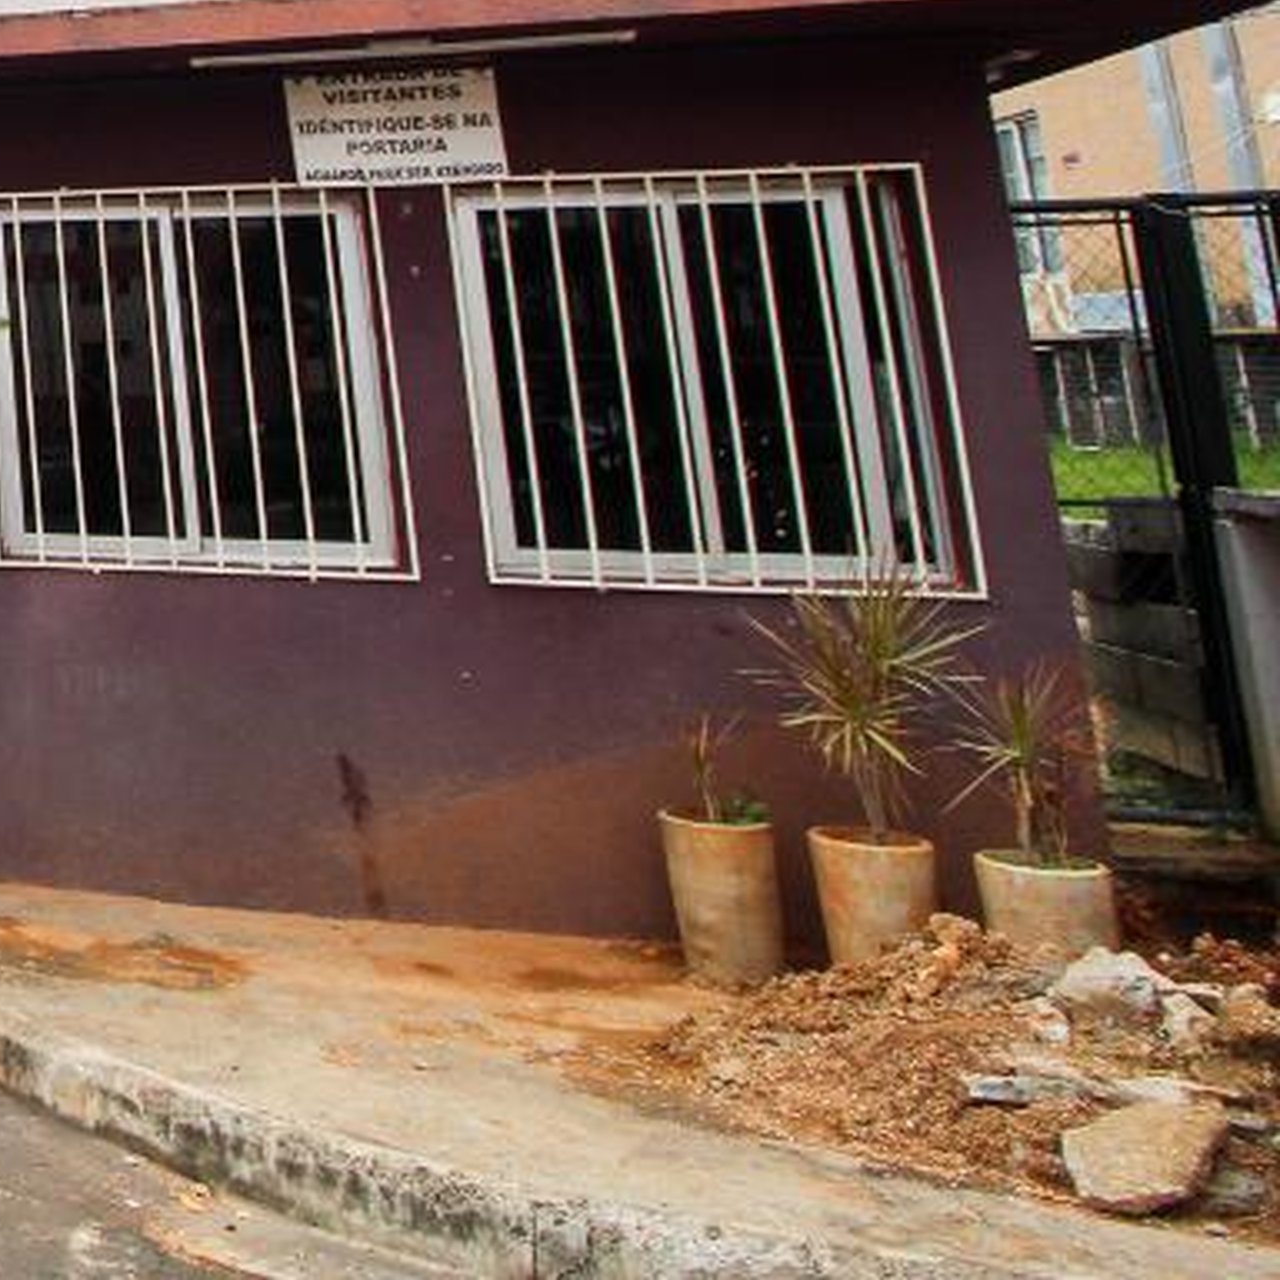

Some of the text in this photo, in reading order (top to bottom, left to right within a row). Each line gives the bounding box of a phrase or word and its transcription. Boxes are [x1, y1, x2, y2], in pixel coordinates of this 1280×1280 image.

[322, 83, 463, 105] VISITANTES
[297, 112, 493, 134] IDENTIFIQUE-SE NA
[346, 137, 448, 157] PORTARIA
